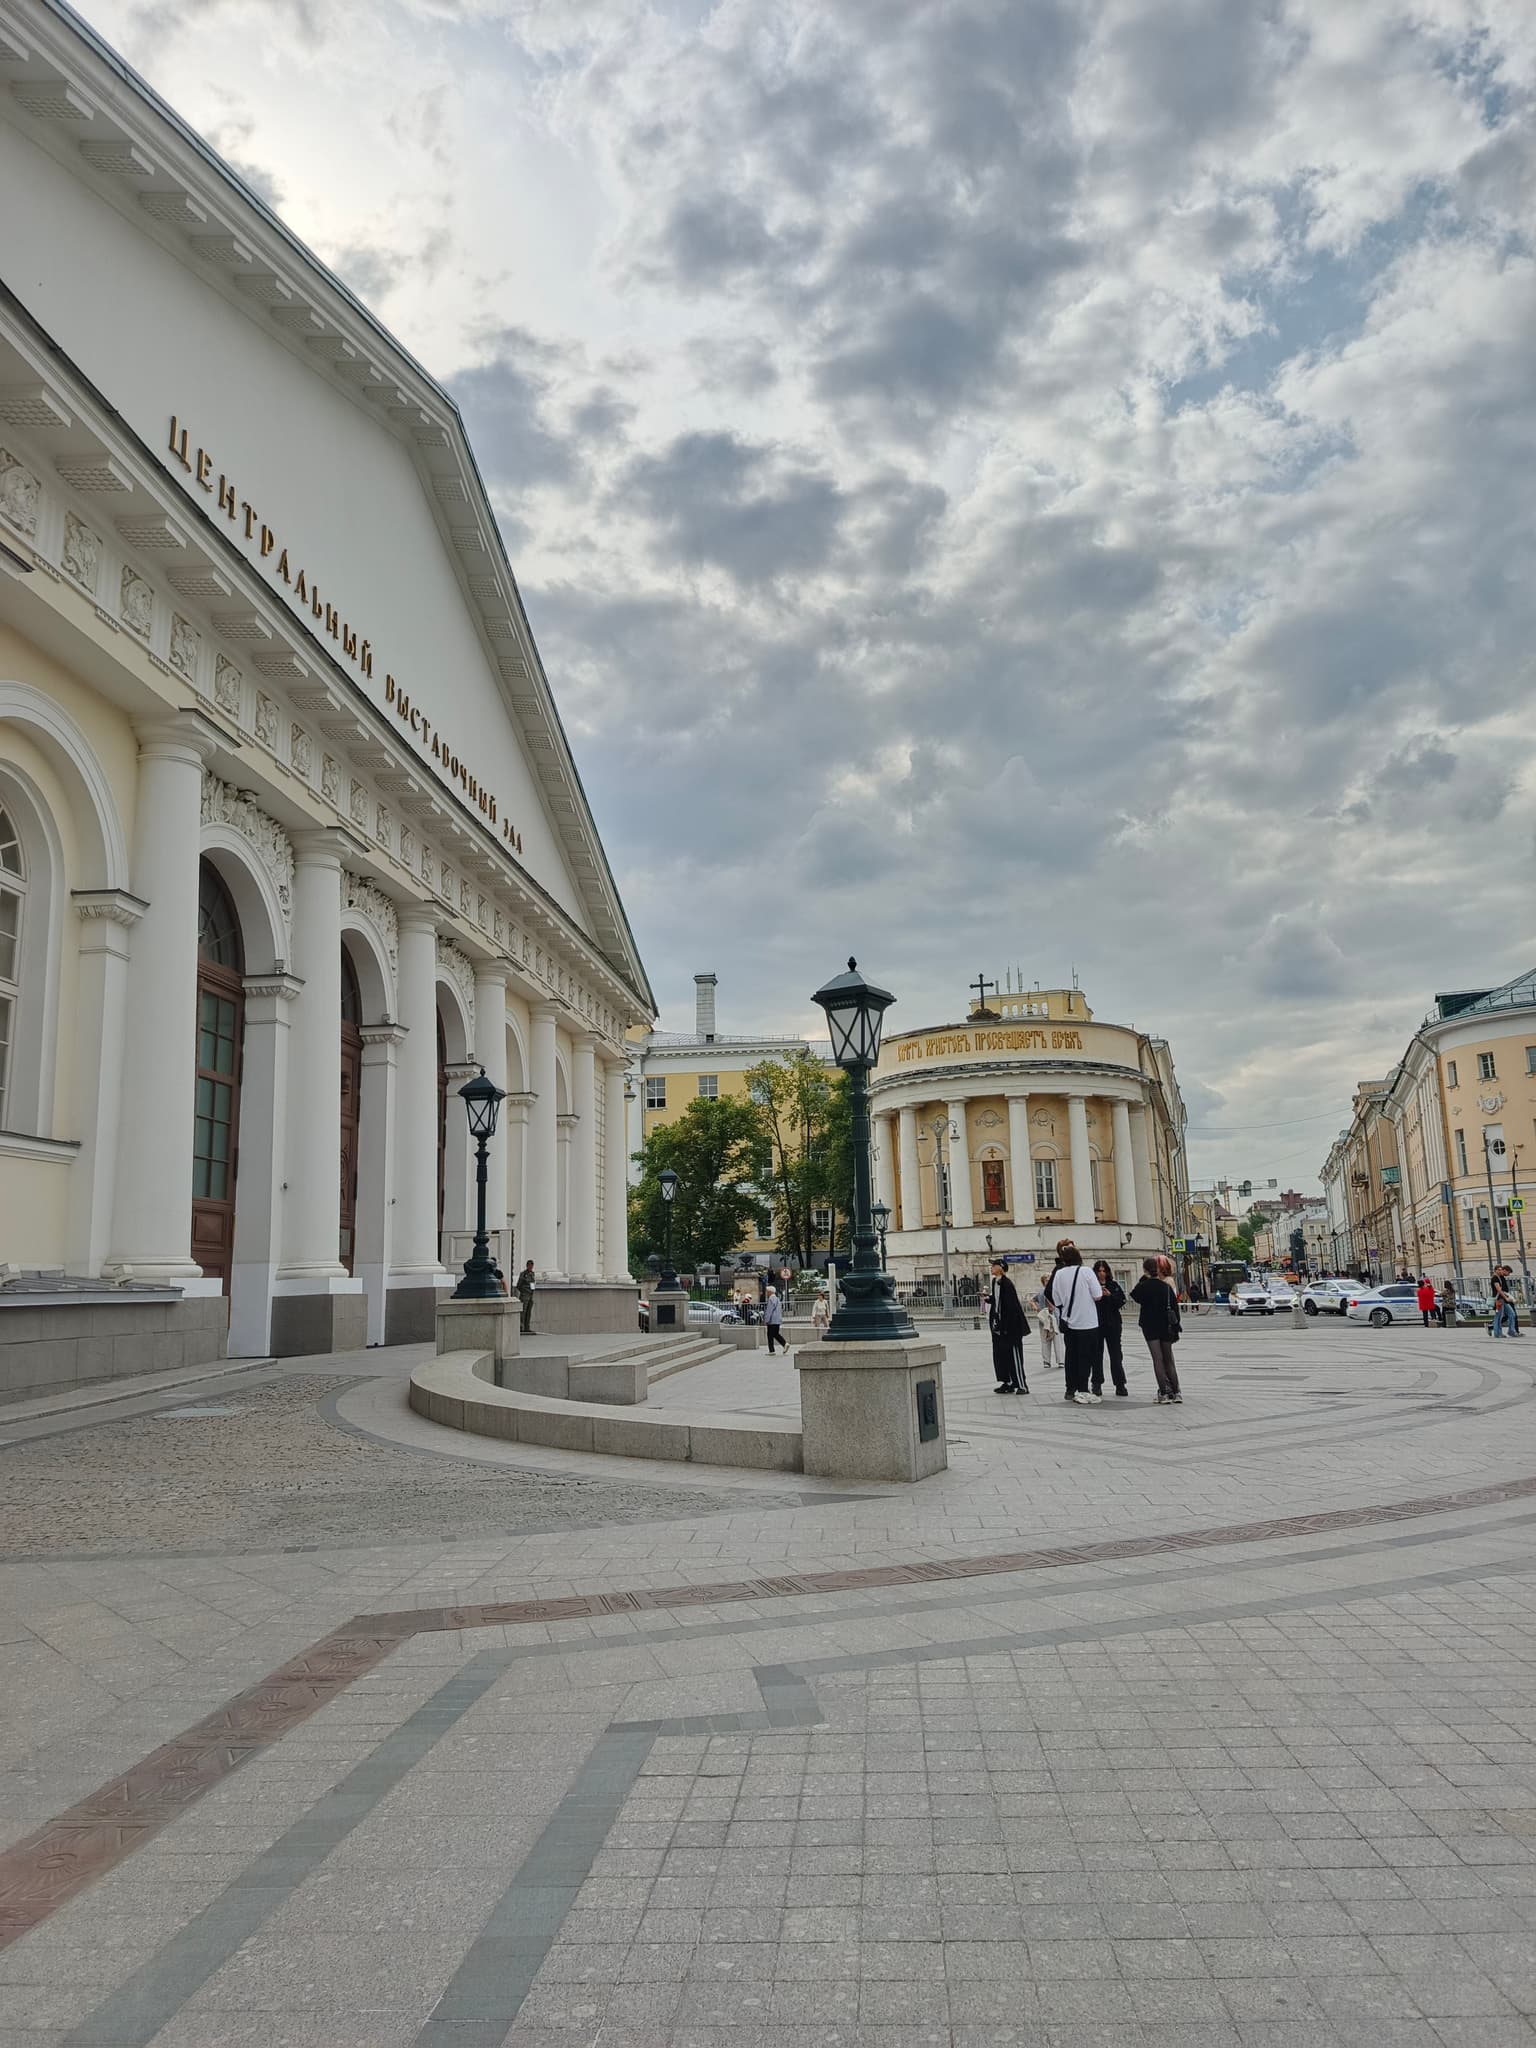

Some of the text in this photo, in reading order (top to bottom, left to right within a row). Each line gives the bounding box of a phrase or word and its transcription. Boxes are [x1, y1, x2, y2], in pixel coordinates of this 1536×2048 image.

[168, 415, 523, 855] ЦЕНТРАЛЬНЫЙ ВЫСТАВОЧНЫЙ ЗАЛ
